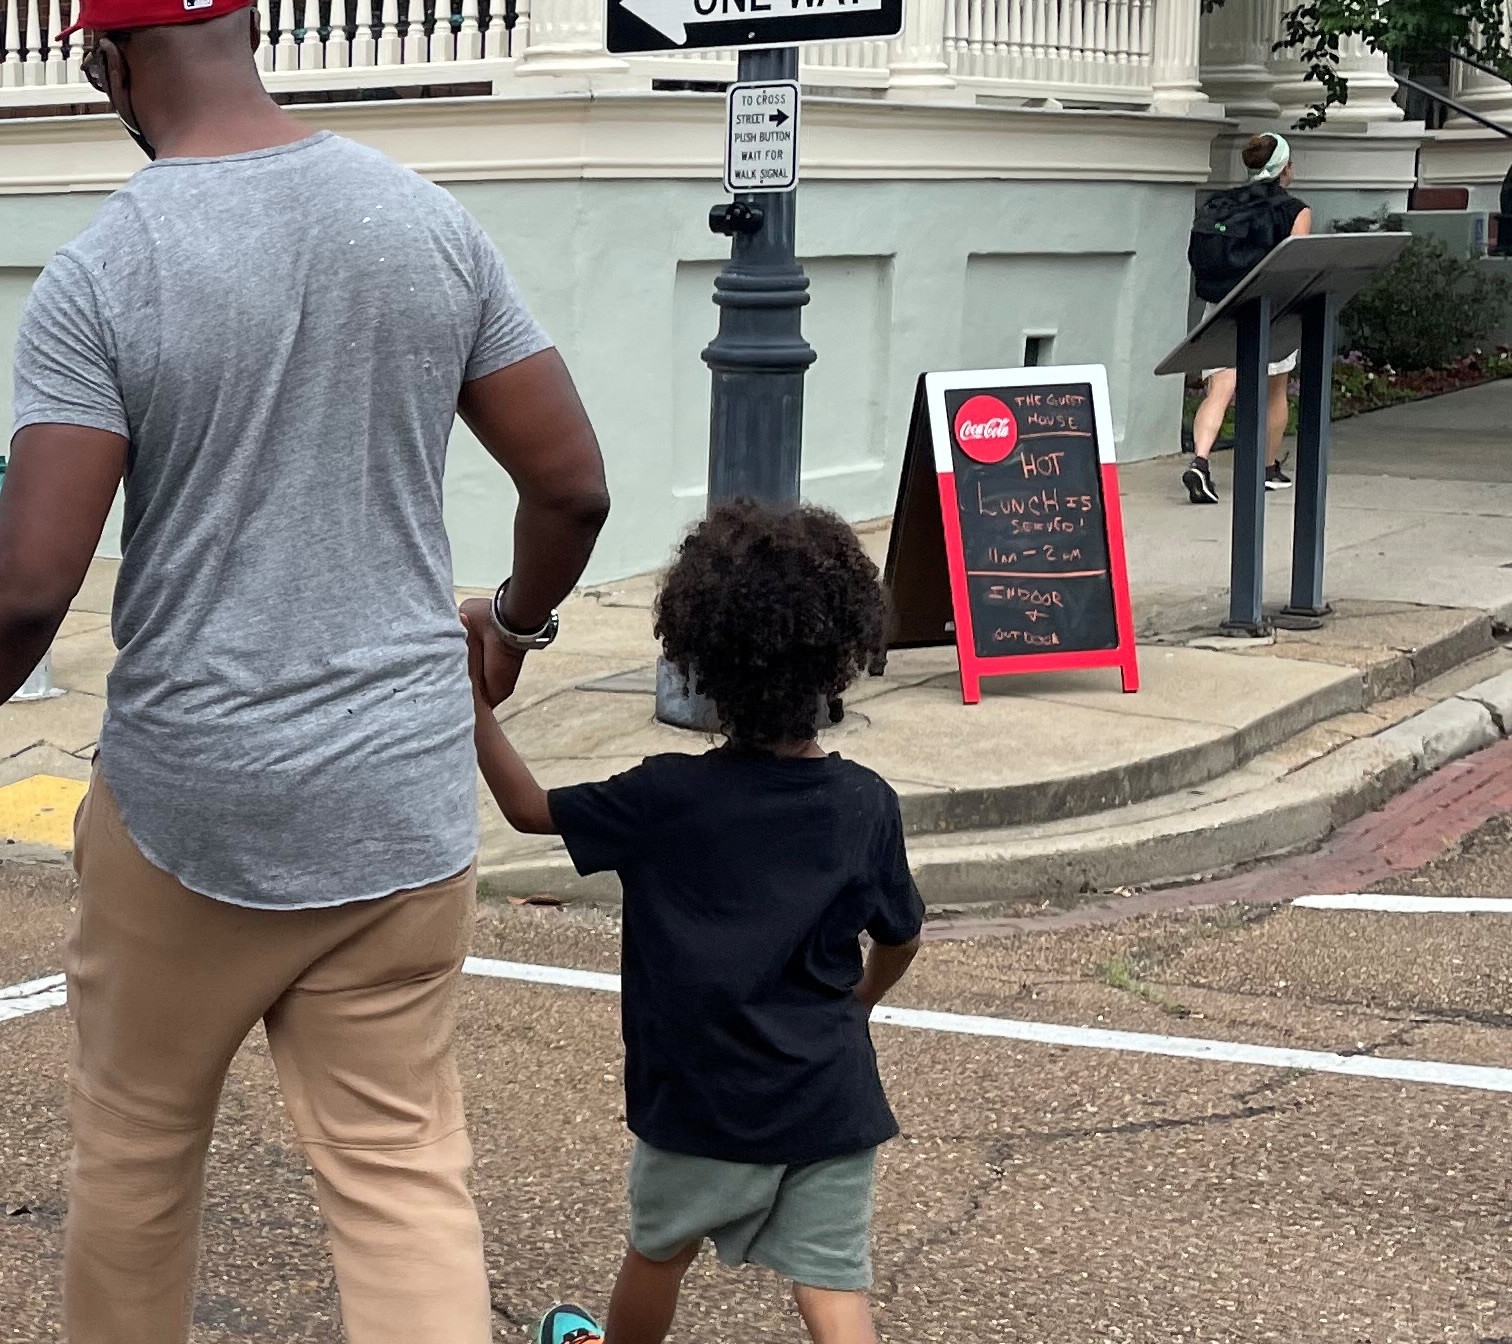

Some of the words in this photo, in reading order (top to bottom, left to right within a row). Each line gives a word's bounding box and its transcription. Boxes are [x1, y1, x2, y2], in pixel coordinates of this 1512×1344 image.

[742, 95, 753, 106] TO
[756, 94, 786, 106] CROSS
[735, 113, 766, 125] STREET
[734, 132, 757, 143] PUSH
[759, 131, 791, 143] BUTTON
[741, 150, 761, 161] WAIT
[765, 149, 784, 160] FOR
[734, 169, 757, 180] WALK
[760, 168, 788, 180] SIGNAL
[1014, 393, 1042, 408] THE
[1028, 412, 1078, 430] HOUSE
[1020, 451, 1065, 479] HOT
[977, 481, 1060, 517] LUNCH
[1066, 495, 1093, 512] IS
[989, 585, 1064, 608] INDOOR
